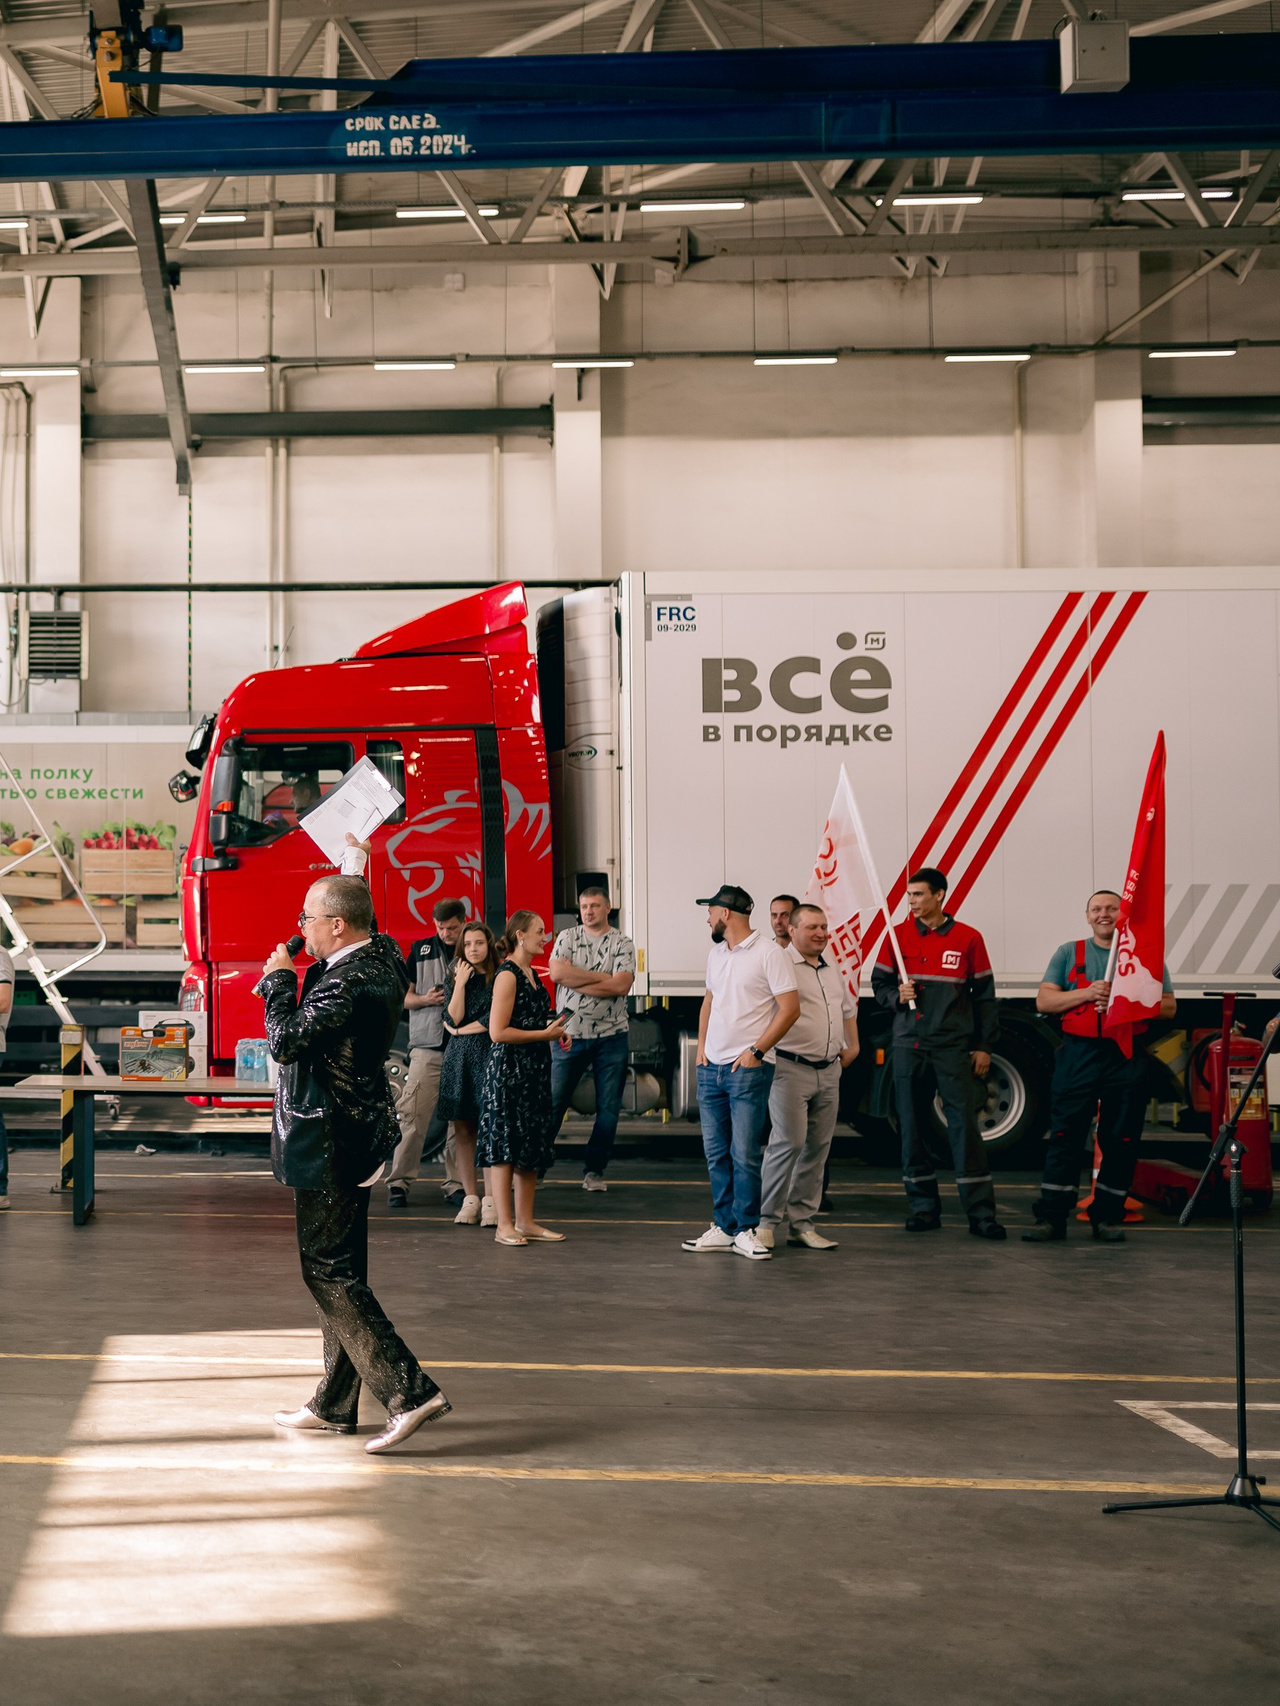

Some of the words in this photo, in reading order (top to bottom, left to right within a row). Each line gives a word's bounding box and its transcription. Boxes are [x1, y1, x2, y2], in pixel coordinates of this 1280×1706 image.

[657, 607, 696, 621] FRC
[657, 624, 697, 632] 09-2029
[734, 724, 893, 748] порядке
[30, 769, 93, 783] полку
[45, 788, 144, 799] свежести
